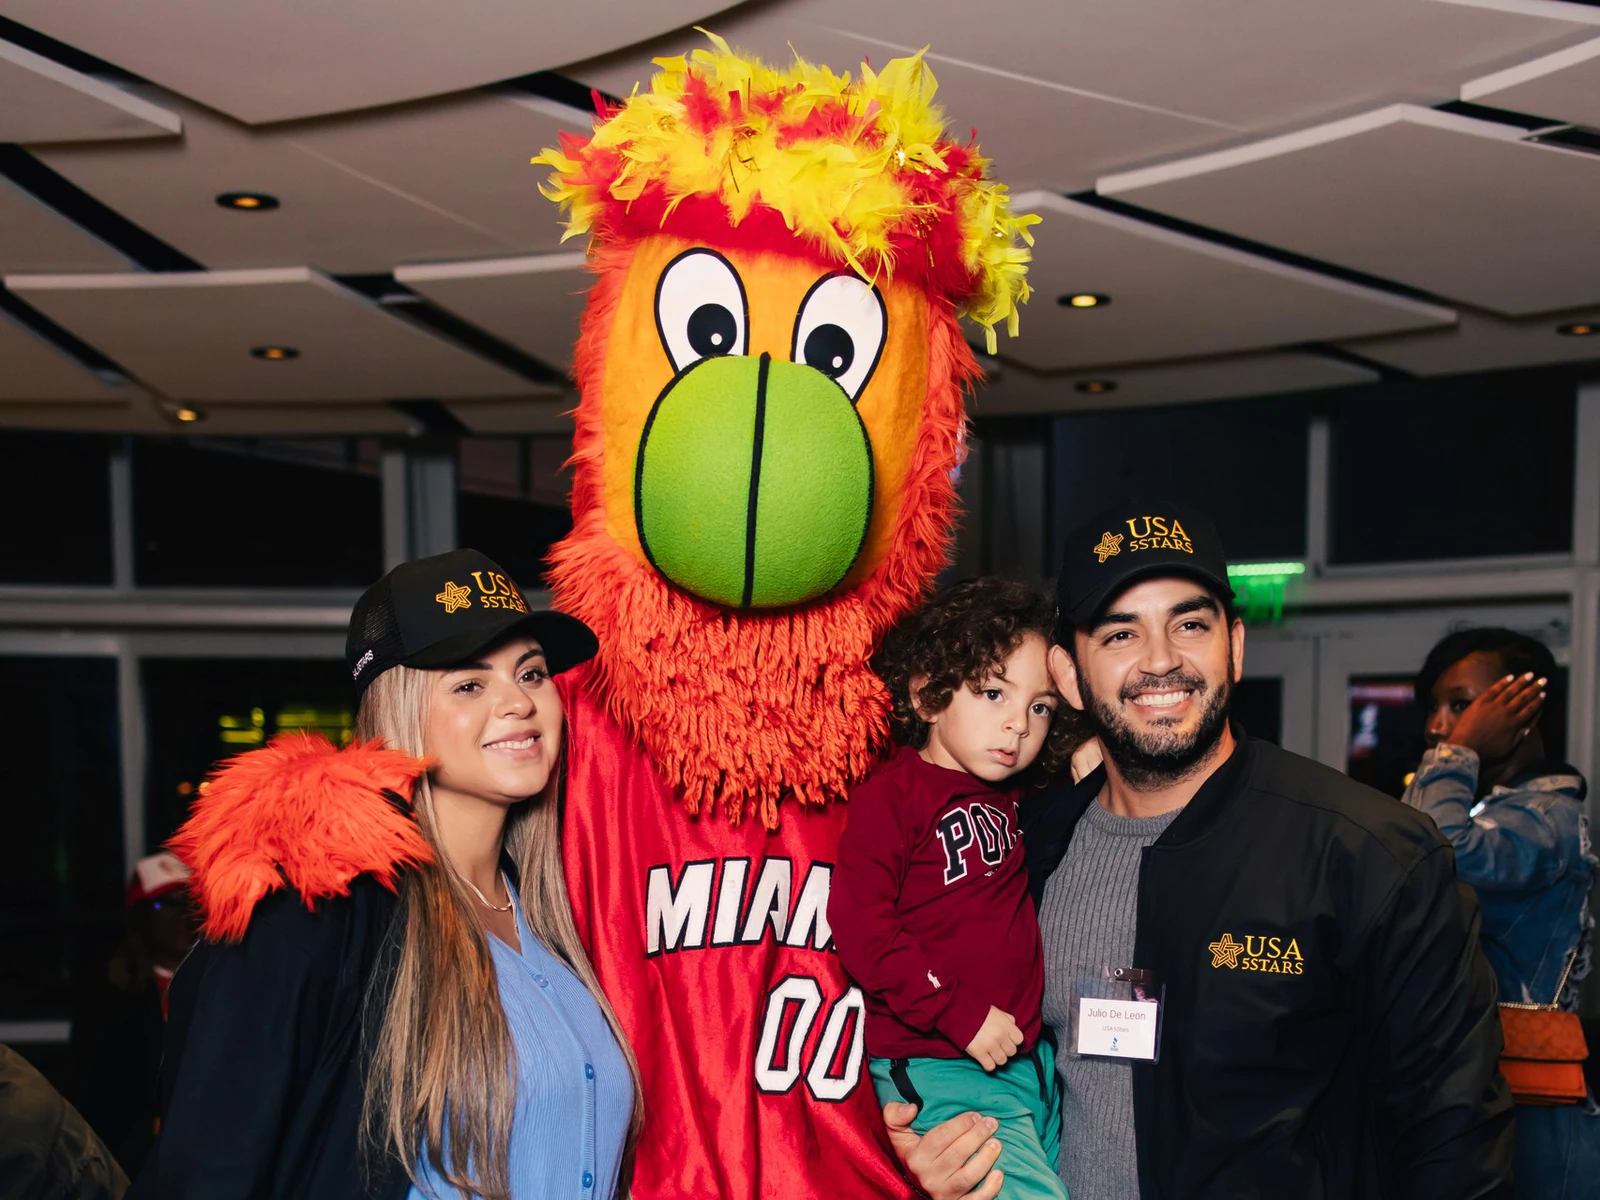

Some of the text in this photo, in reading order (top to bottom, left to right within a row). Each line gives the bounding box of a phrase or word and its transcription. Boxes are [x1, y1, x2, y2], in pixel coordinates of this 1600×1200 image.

[1126, 516, 1192, 542] USA
[1129, 536, 1194, 554] 5STARS
[480, 596, 528, 614] 5STAR
[936, 802, 1024, 886] POL
[645, 856, 837, 959] MIAM
[1244, 935, 1304, 961] USA
[1241, 957, 1304, 975] 5STARS
[1087, 1008, 1146, 1021] Julio De Leon
[754, 974, 867, 1104] 00
